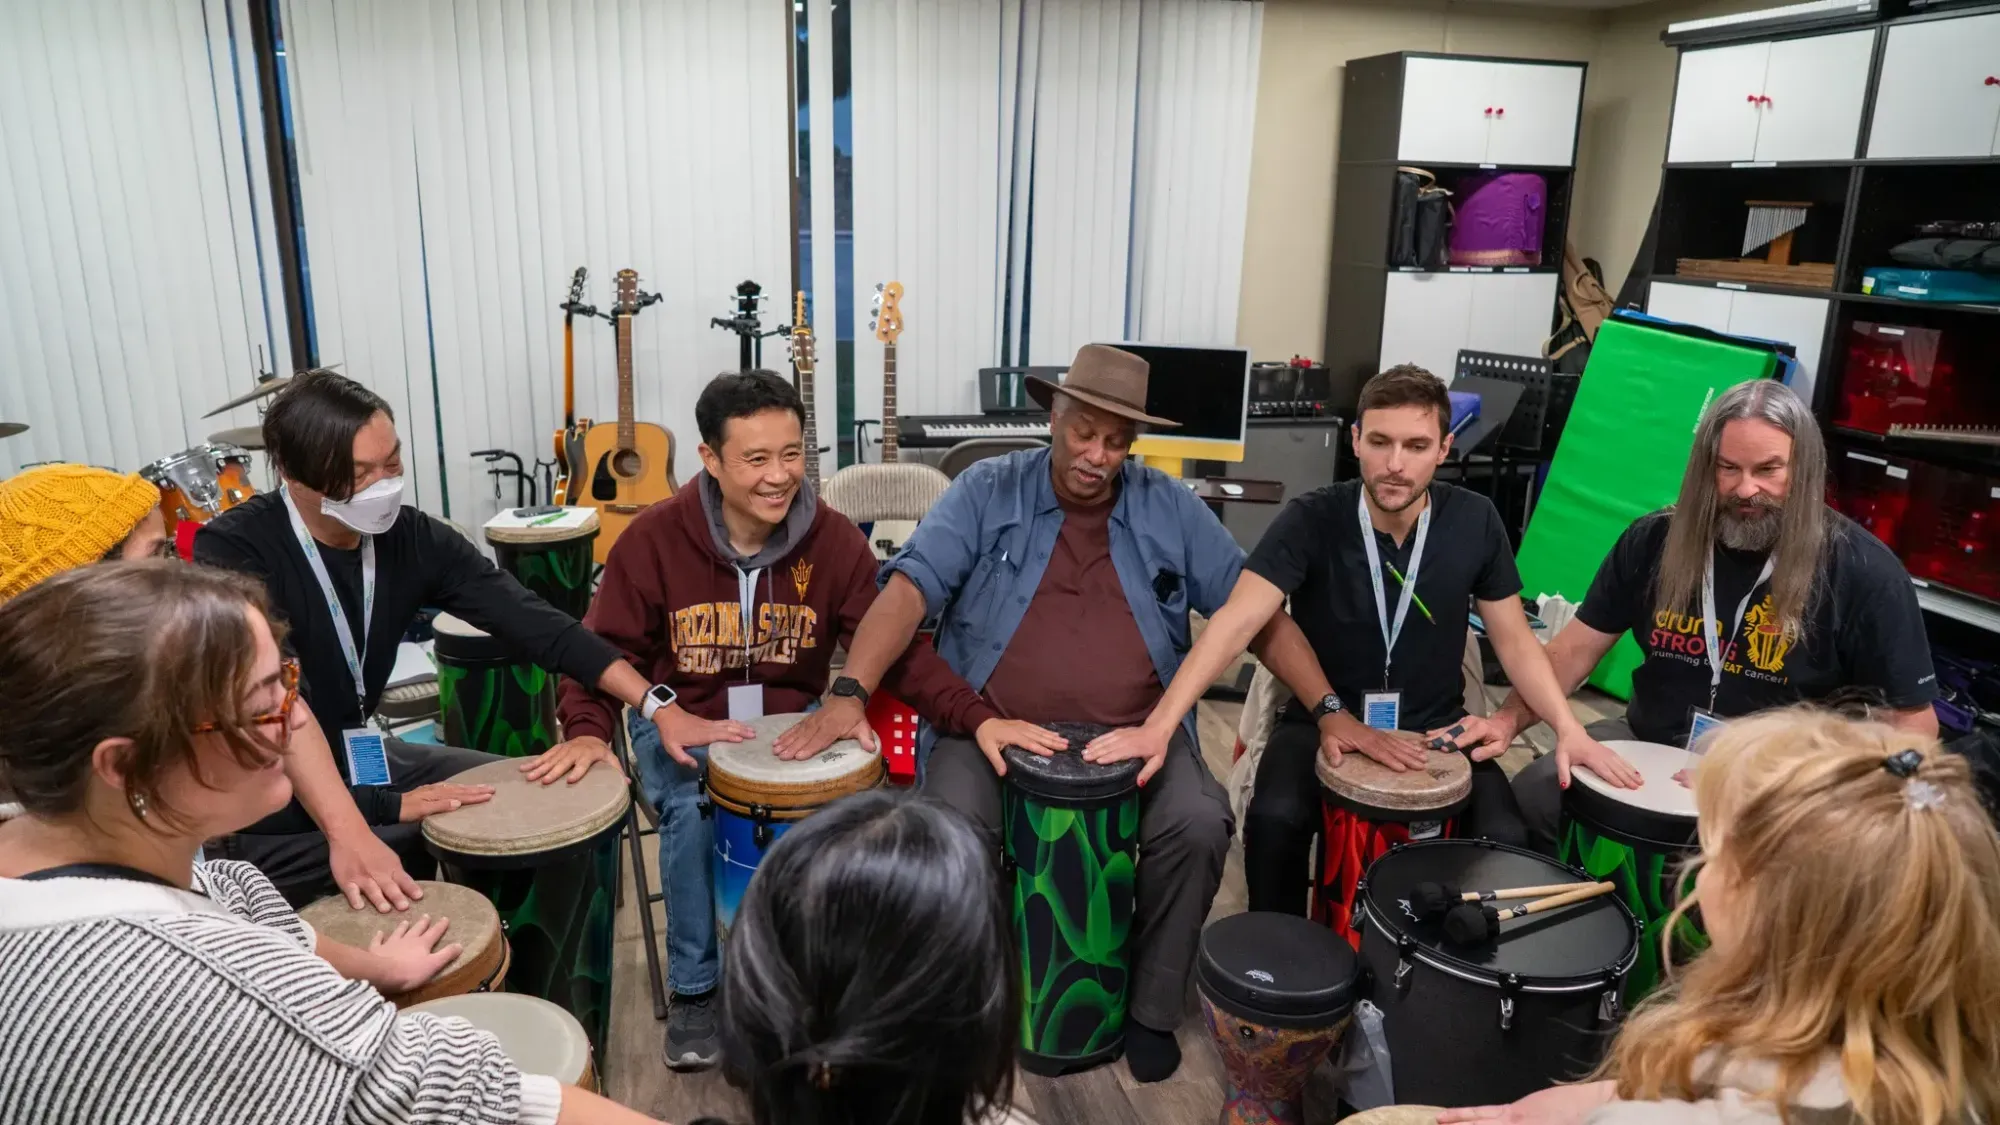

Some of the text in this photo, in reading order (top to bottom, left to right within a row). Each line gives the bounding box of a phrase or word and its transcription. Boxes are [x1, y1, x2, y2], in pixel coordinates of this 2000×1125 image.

[1652, 649, 1700, 667] rumming
[1723, 661, 1744, 674] EAT
[1744, 668, 1788, 686] cancer!
